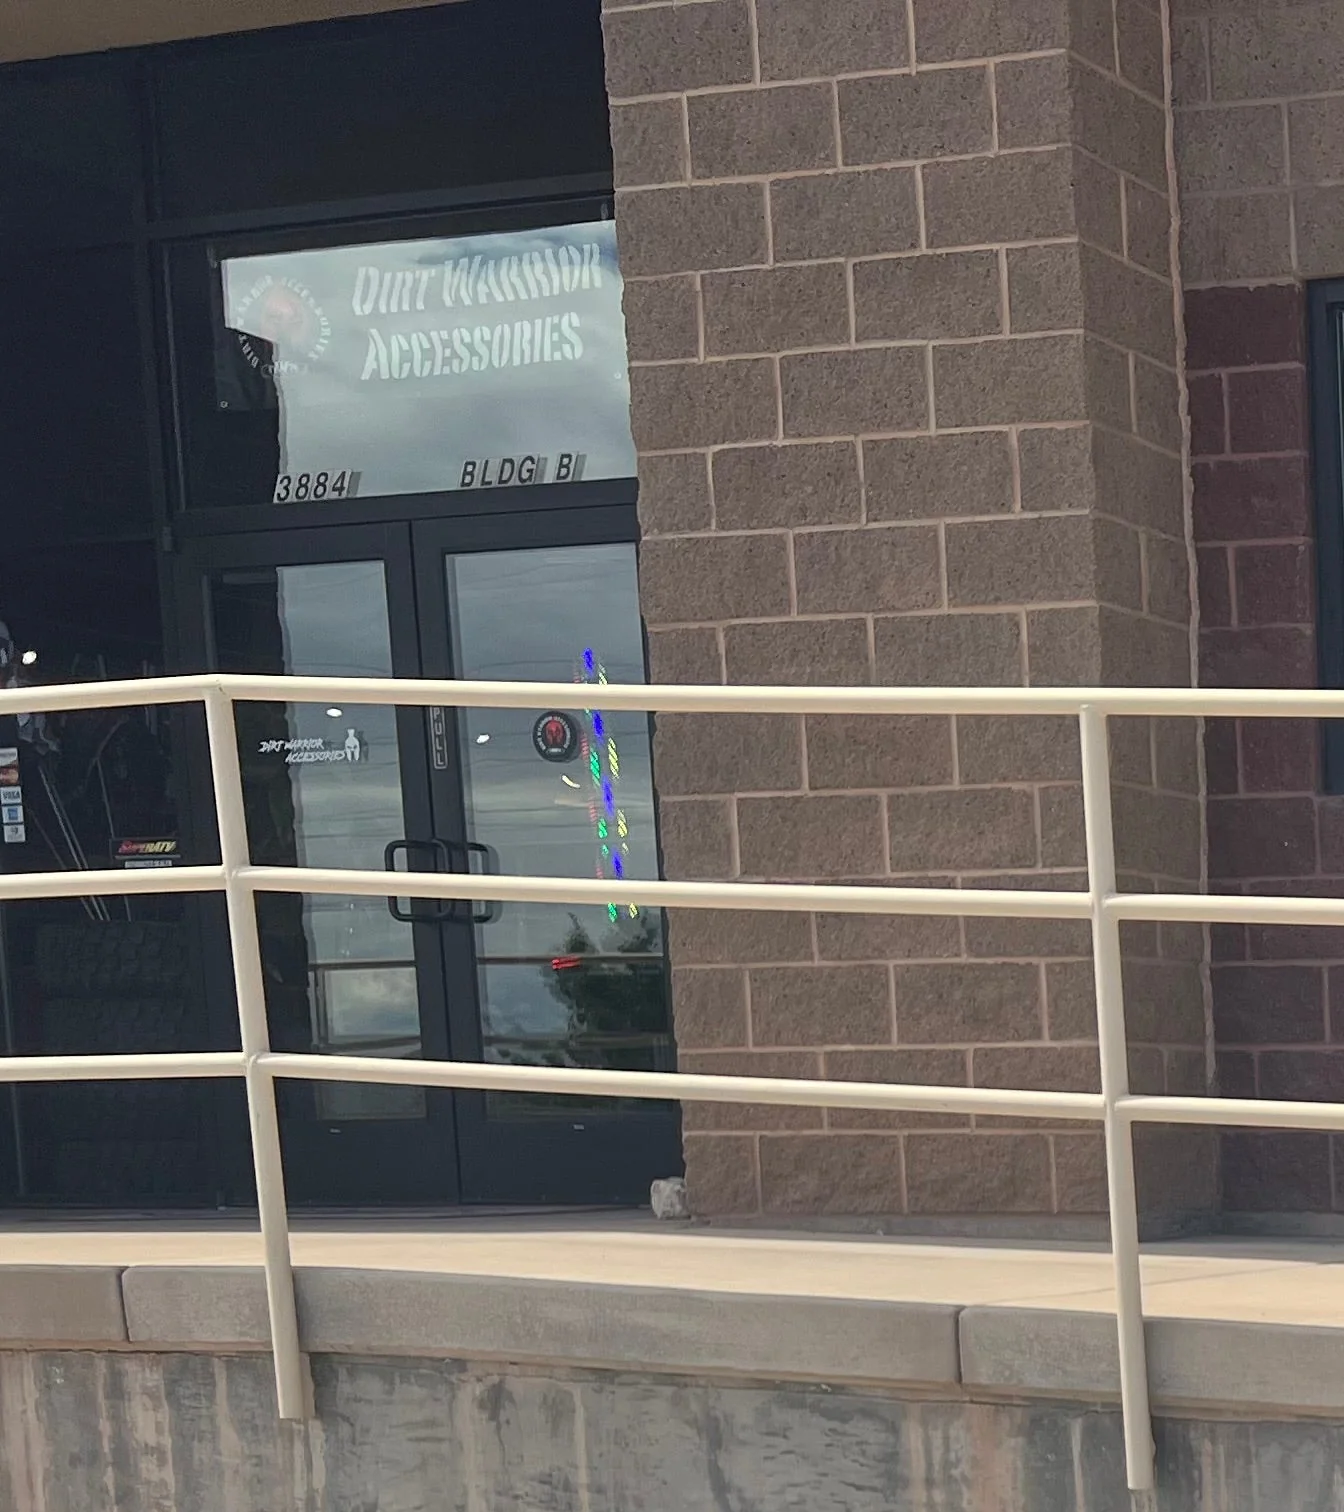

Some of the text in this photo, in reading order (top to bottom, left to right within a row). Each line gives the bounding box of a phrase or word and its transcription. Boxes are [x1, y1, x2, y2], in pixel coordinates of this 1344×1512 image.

[443, 243, 602, 307] WARRIOR
[360, 312, 584, 380] ACCESSORIES
[276, 470, 348, 502] 3884
[460, 452, 574, 488] BLDG B
[433, 707, 444, 765] PULL
